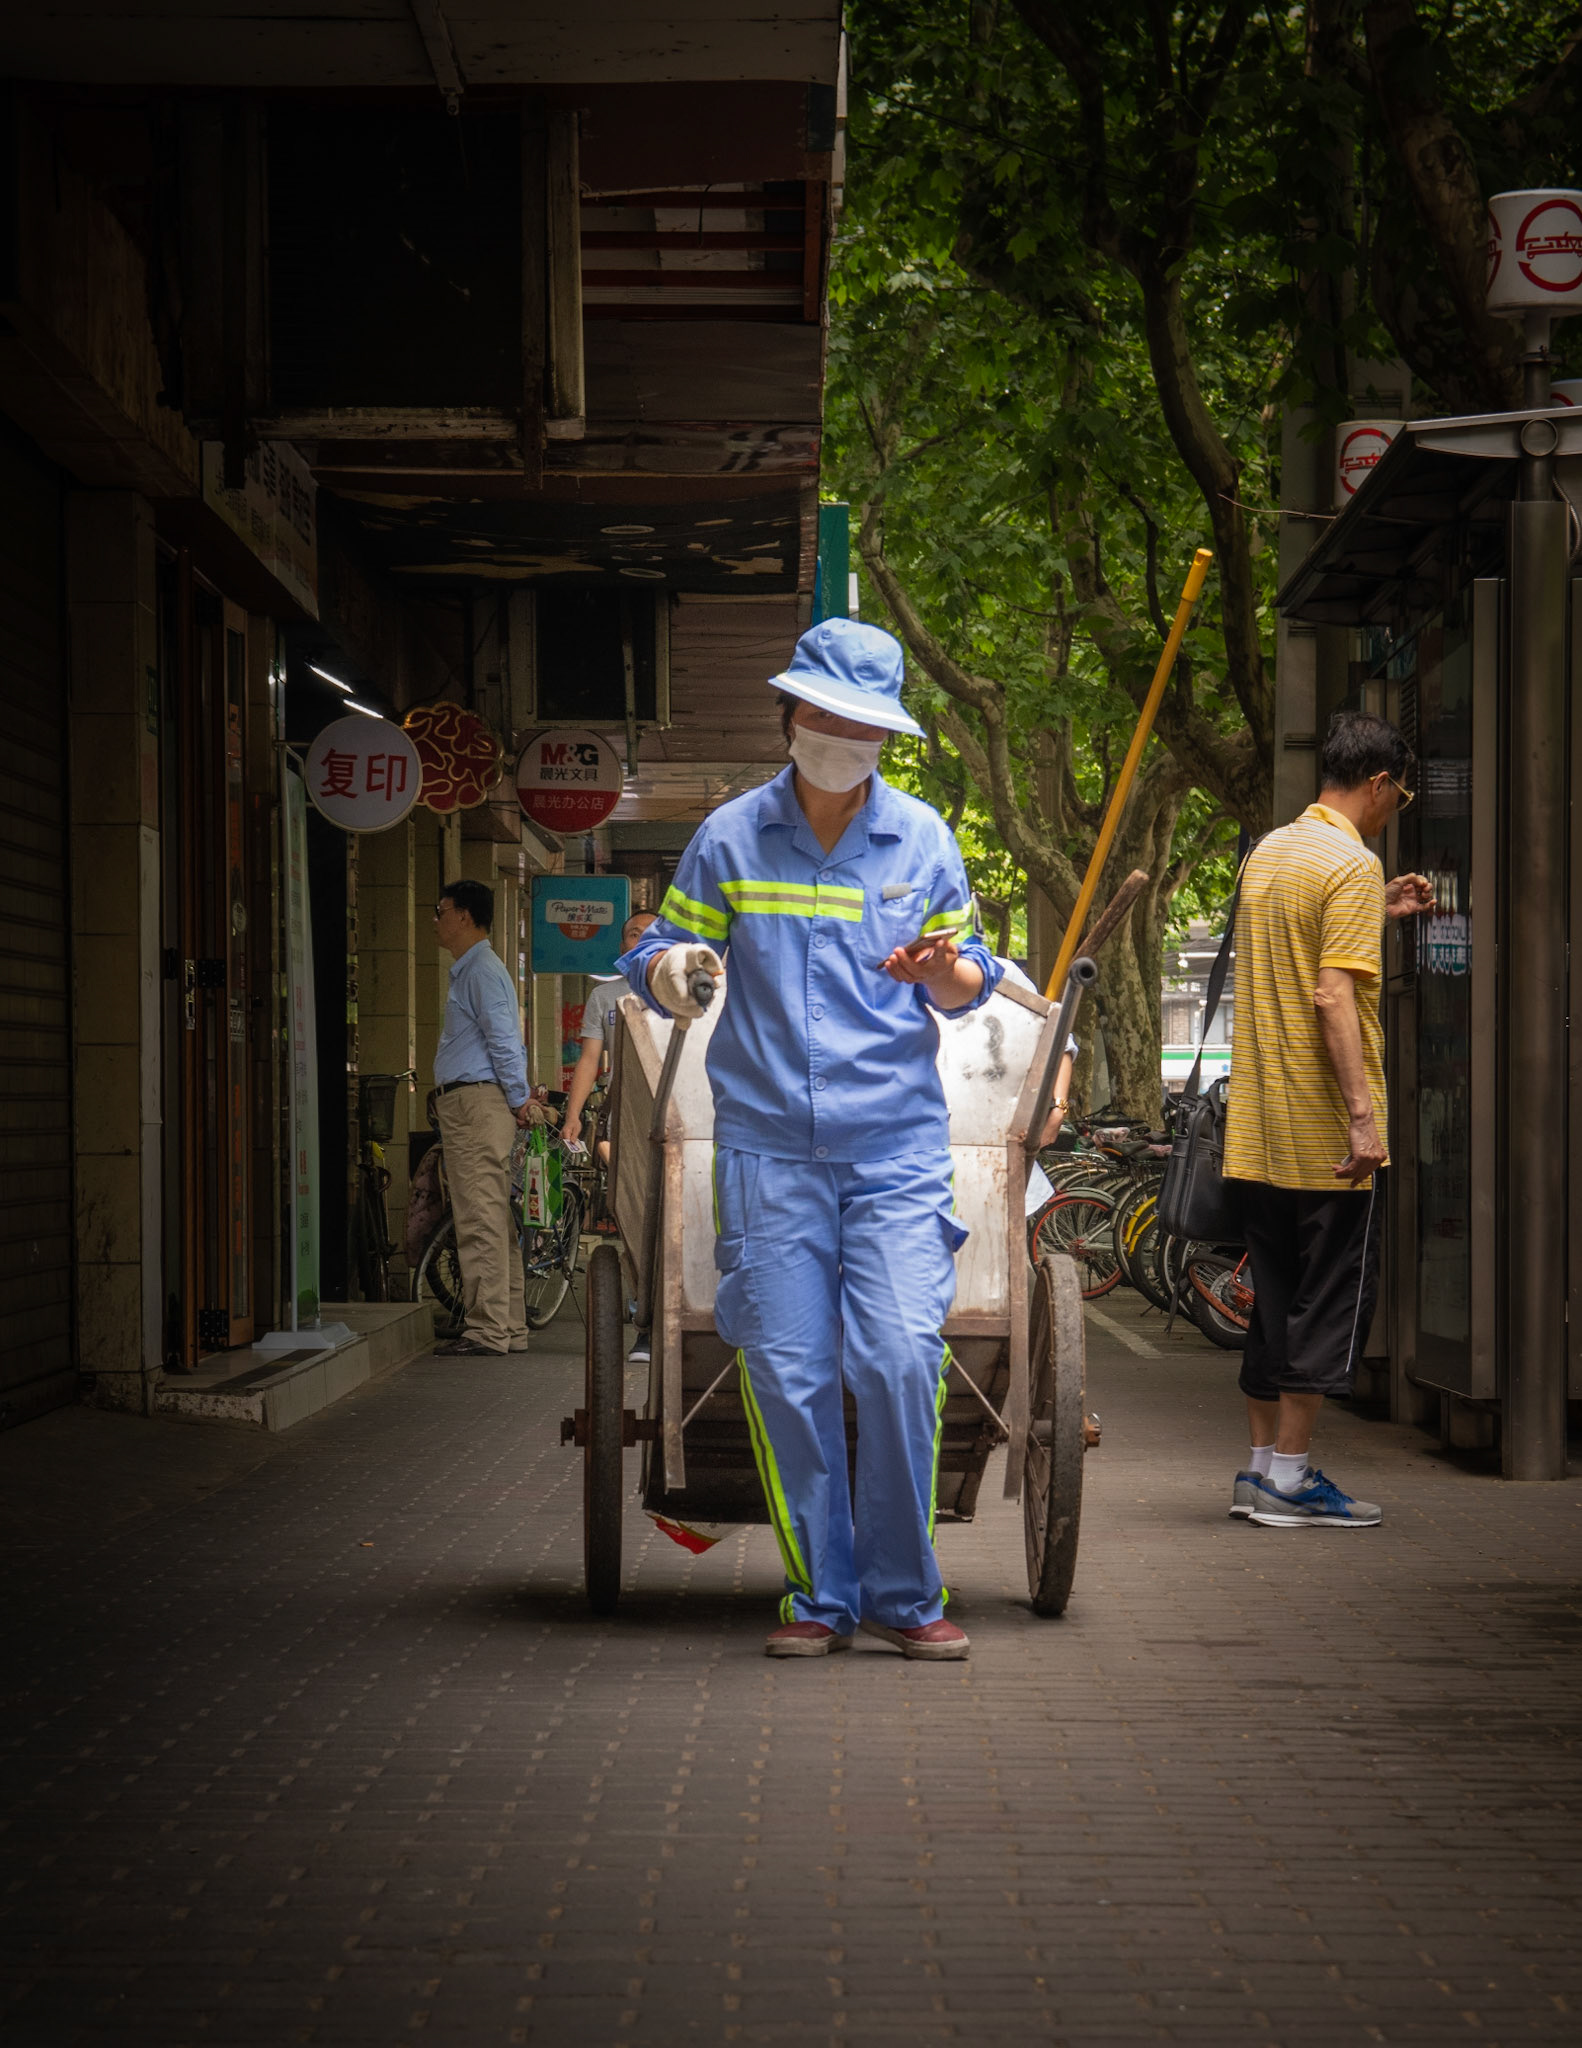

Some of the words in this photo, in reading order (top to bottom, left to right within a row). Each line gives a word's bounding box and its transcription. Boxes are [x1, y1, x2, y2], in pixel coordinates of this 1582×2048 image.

[541, 743, 599, 765] M&G
[320, 748, 408, 801] 复印
[540, 767, 597, 781] 晨光文具
[533, 794, 604, 810] 晨光办公店
[552, 901, 580, 914] Paper
[586, 904, 608, 915] Mate
